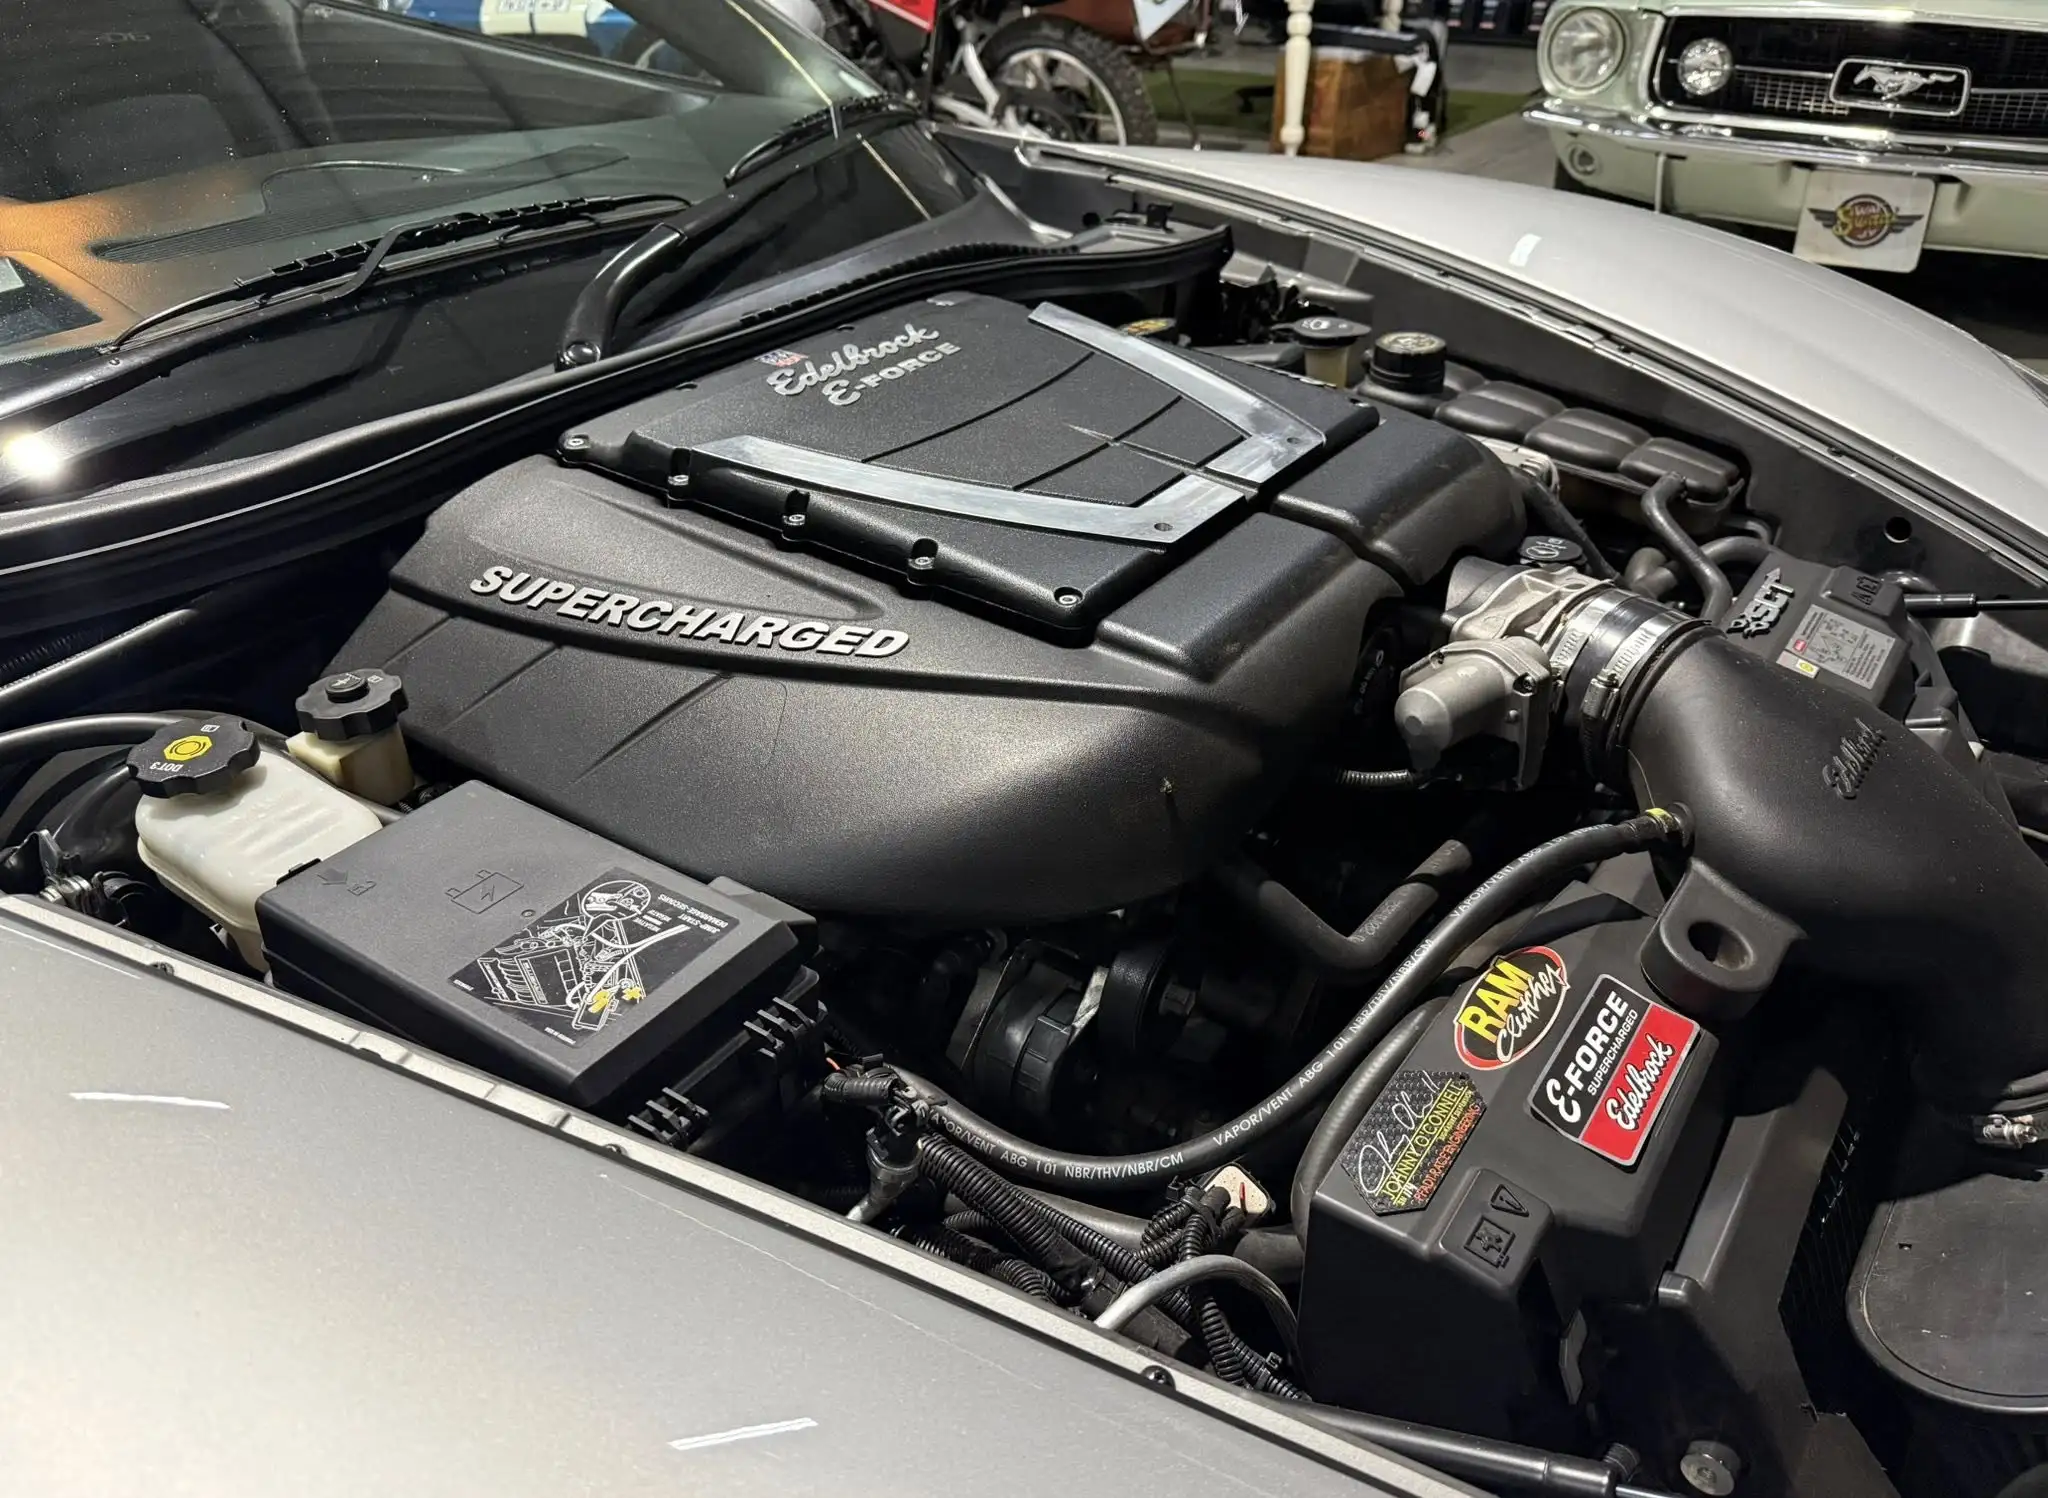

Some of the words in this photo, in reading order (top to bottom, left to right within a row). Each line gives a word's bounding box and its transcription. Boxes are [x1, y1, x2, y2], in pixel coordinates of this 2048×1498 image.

[766, 323, 940, 396] Edelbrock
[821, 342, 961, 406] E-FORCE
[469, 565, 910, 658] SUPERCHARGED
[1458, 961, 1534, 1043] RAM
[1546, 991, 1629, 1124] E-FORCE
[1587, 1009, 1638, 1096] SUPERCHARGED
[1605, 1033, 1673, 1131] Edelbrock
[1213, 1087, 1293, 1146] VAPOR/VENT
[1299, 1061, 1323, 1088] ABG
[1381, 1145, 1422, 1200] JOHNNY
[1414, 1083, 1465, 1148] O'CONNELL
[1000, 1151, 1028, 1168] ABG
[1065, 1151, 1184, 1179] NBR/THV/NBR/CM
